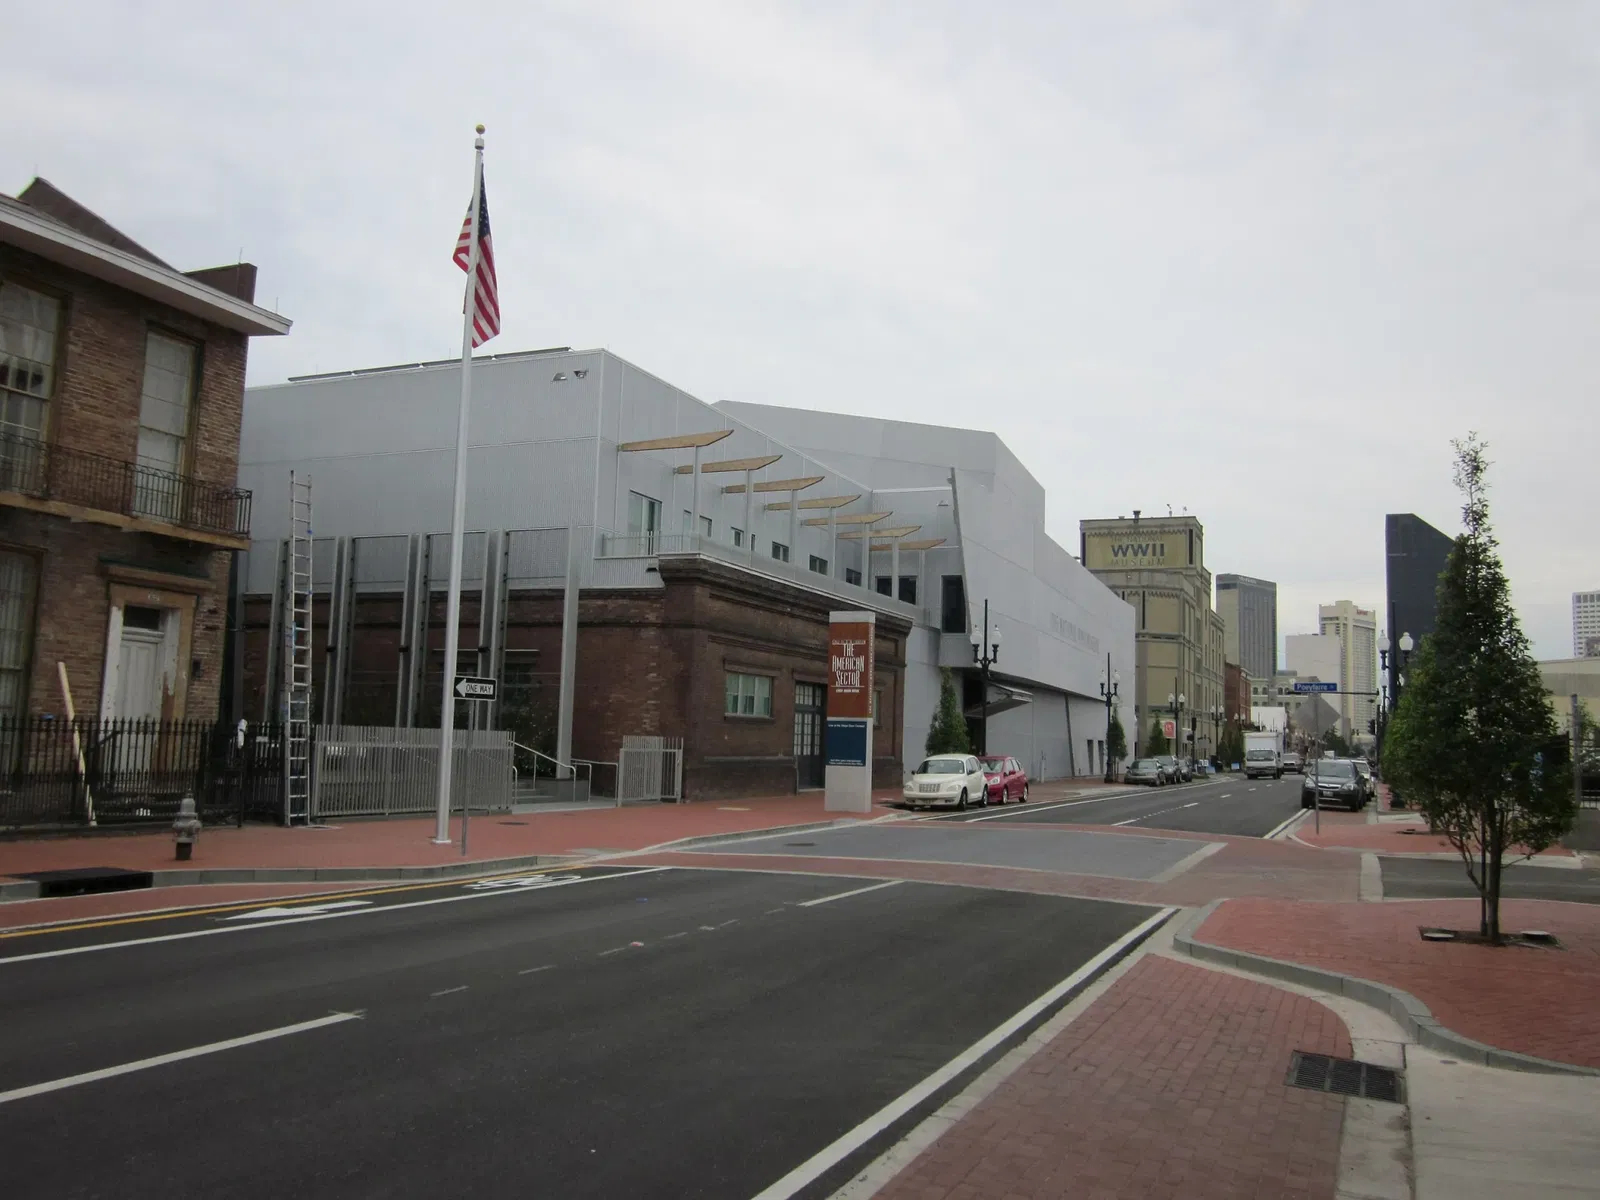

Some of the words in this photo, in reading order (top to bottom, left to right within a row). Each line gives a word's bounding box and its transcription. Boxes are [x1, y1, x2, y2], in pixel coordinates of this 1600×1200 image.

[1111, 543, 1164, 557] WWII
[844, 643, 854, 657] THE
[832, 655, 865, 672] AMERICAN
[836, 670, 860, 687] SECTOR
[466, 683, 479, 693] ONE
[480, 685, 492, 694] WAY
